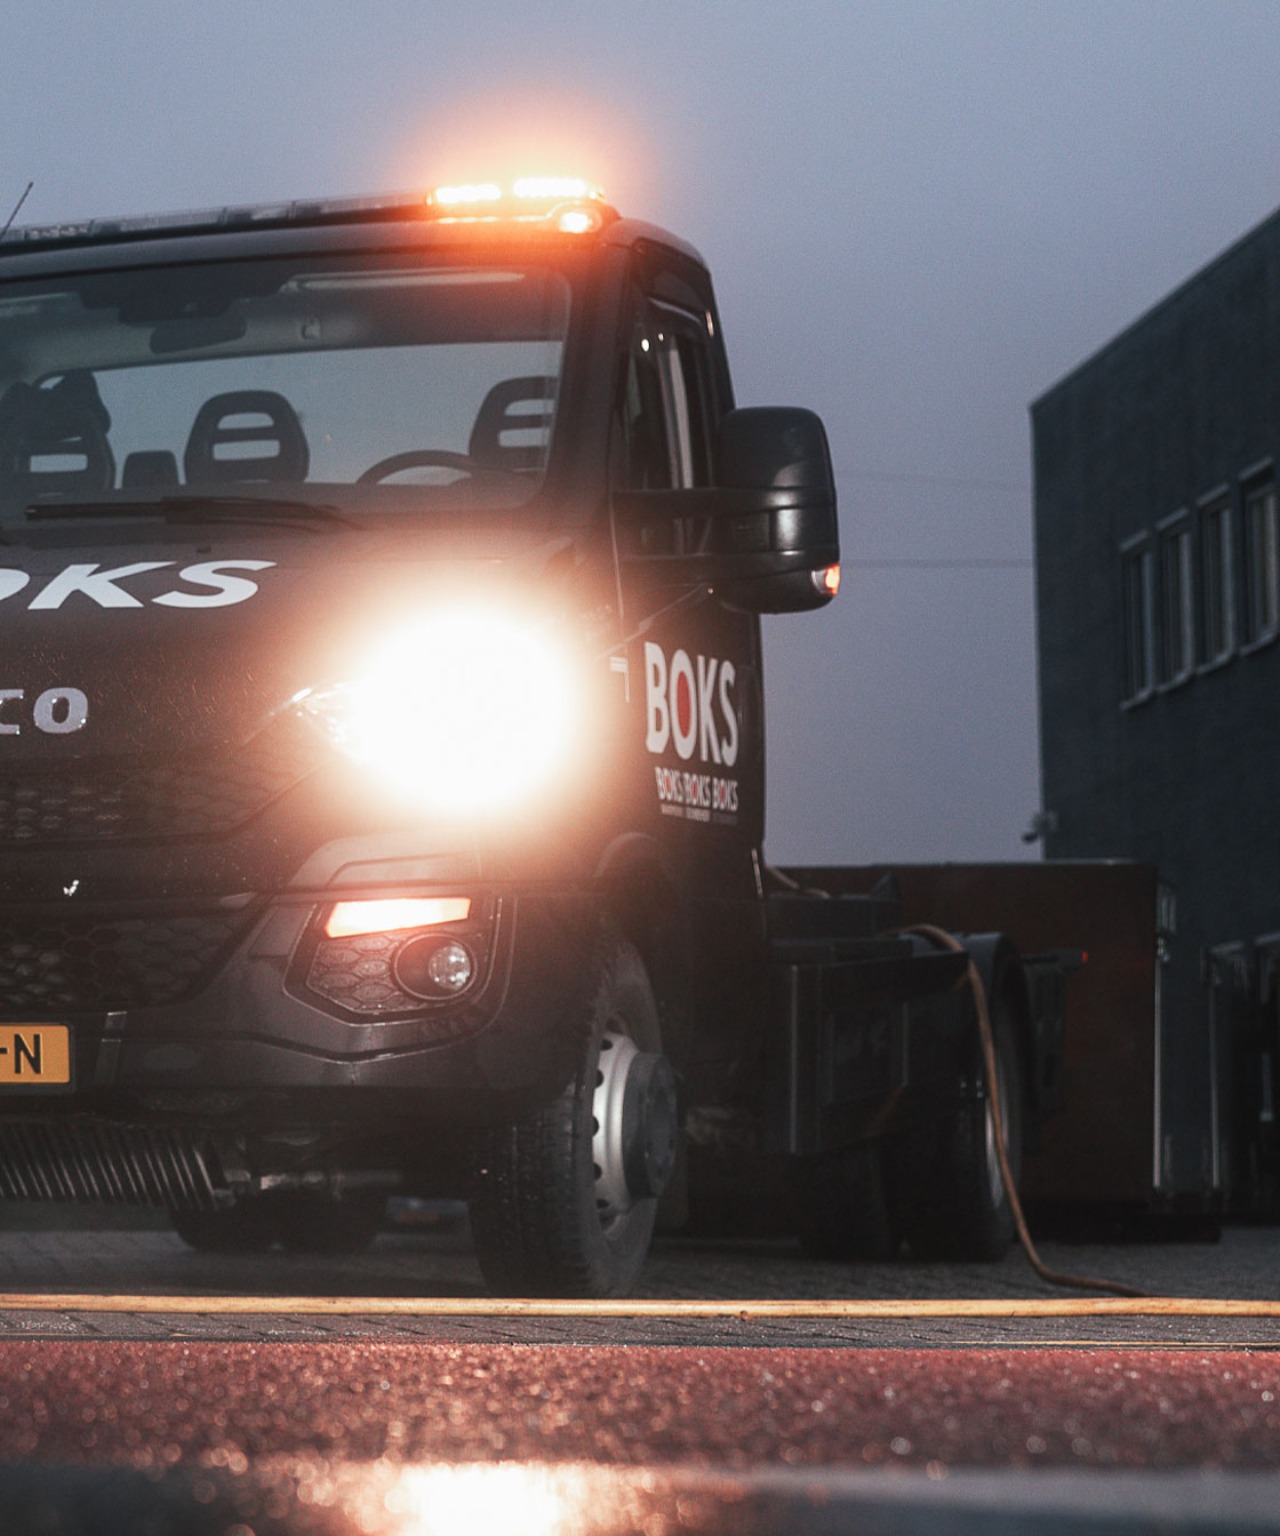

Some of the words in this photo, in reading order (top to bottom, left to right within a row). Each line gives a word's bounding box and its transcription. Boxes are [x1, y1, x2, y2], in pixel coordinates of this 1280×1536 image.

[644, 641, 738, 767] BOKS
[655, 766, 683, 804] BOKS
[683, 771, 711, 808] BOKS
[712, 776, 739, 812] BOKS
